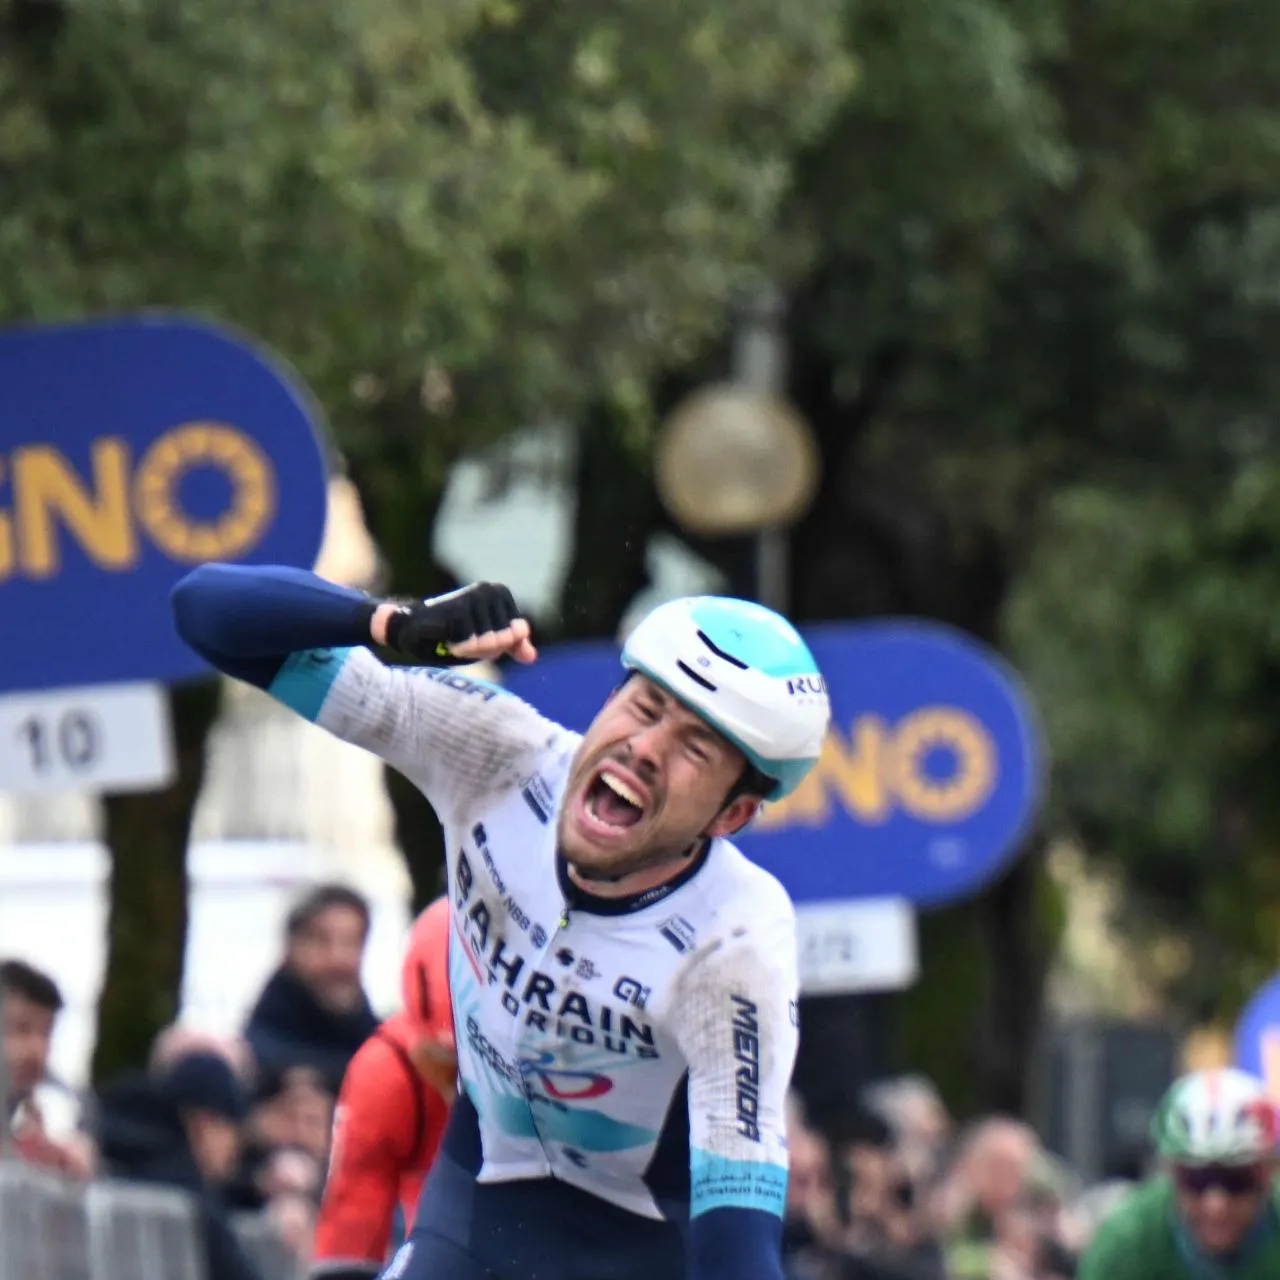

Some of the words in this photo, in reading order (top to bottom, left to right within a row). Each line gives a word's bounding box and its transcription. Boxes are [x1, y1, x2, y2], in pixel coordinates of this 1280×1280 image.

[17, 706, 104, 776] 10
[456, 847, 656, 1046] BAHRAIN
[730, 993, 761, 1144] MERIDA
